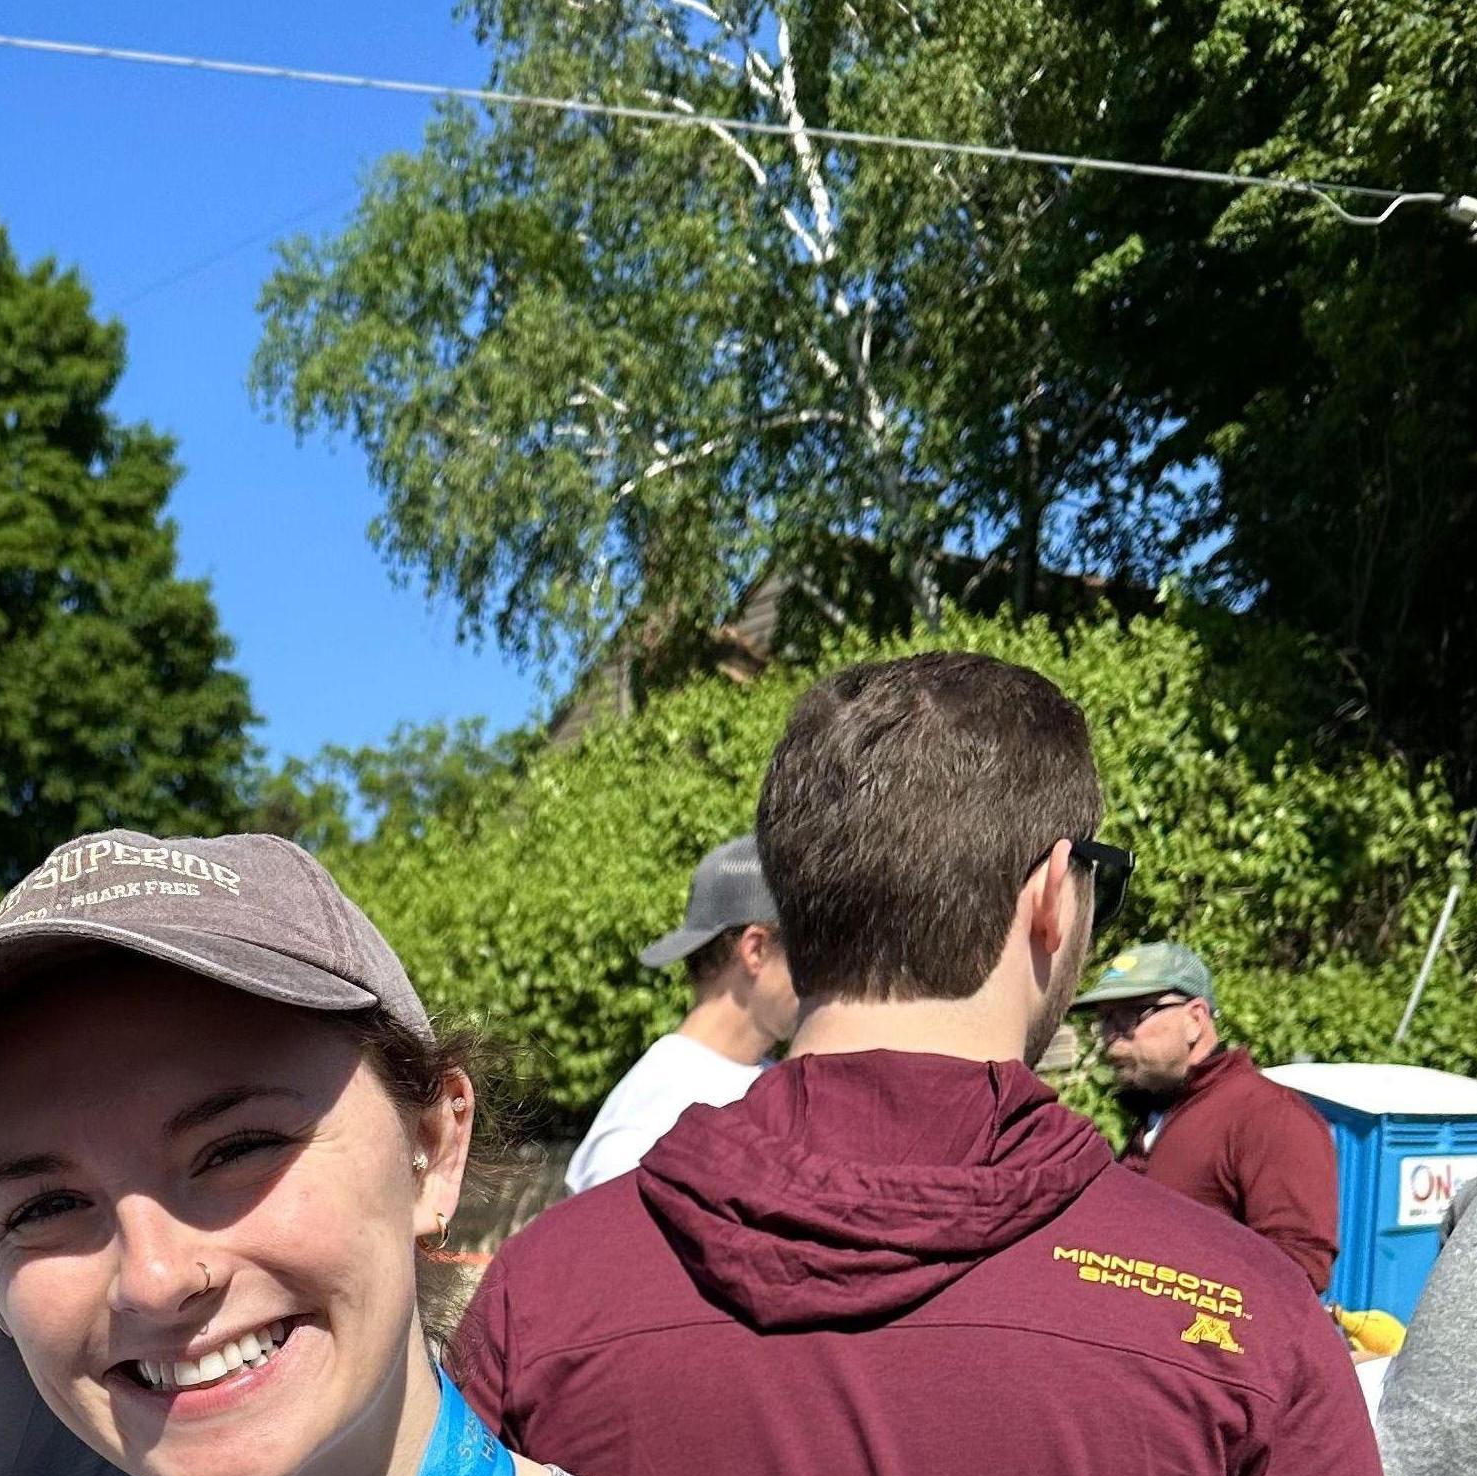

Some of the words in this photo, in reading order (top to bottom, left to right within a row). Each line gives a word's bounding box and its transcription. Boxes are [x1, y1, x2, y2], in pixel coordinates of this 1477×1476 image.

[32, 839, 241, 896] SUPERIOR
[144, 880, 201, 897] FREE
[1053, 1246, 1244, 1303] MINNESOTA
[1078, 1265, 1243, 1319] SKI-U-MAH
[1180, 1312, 1240, 1354] M
